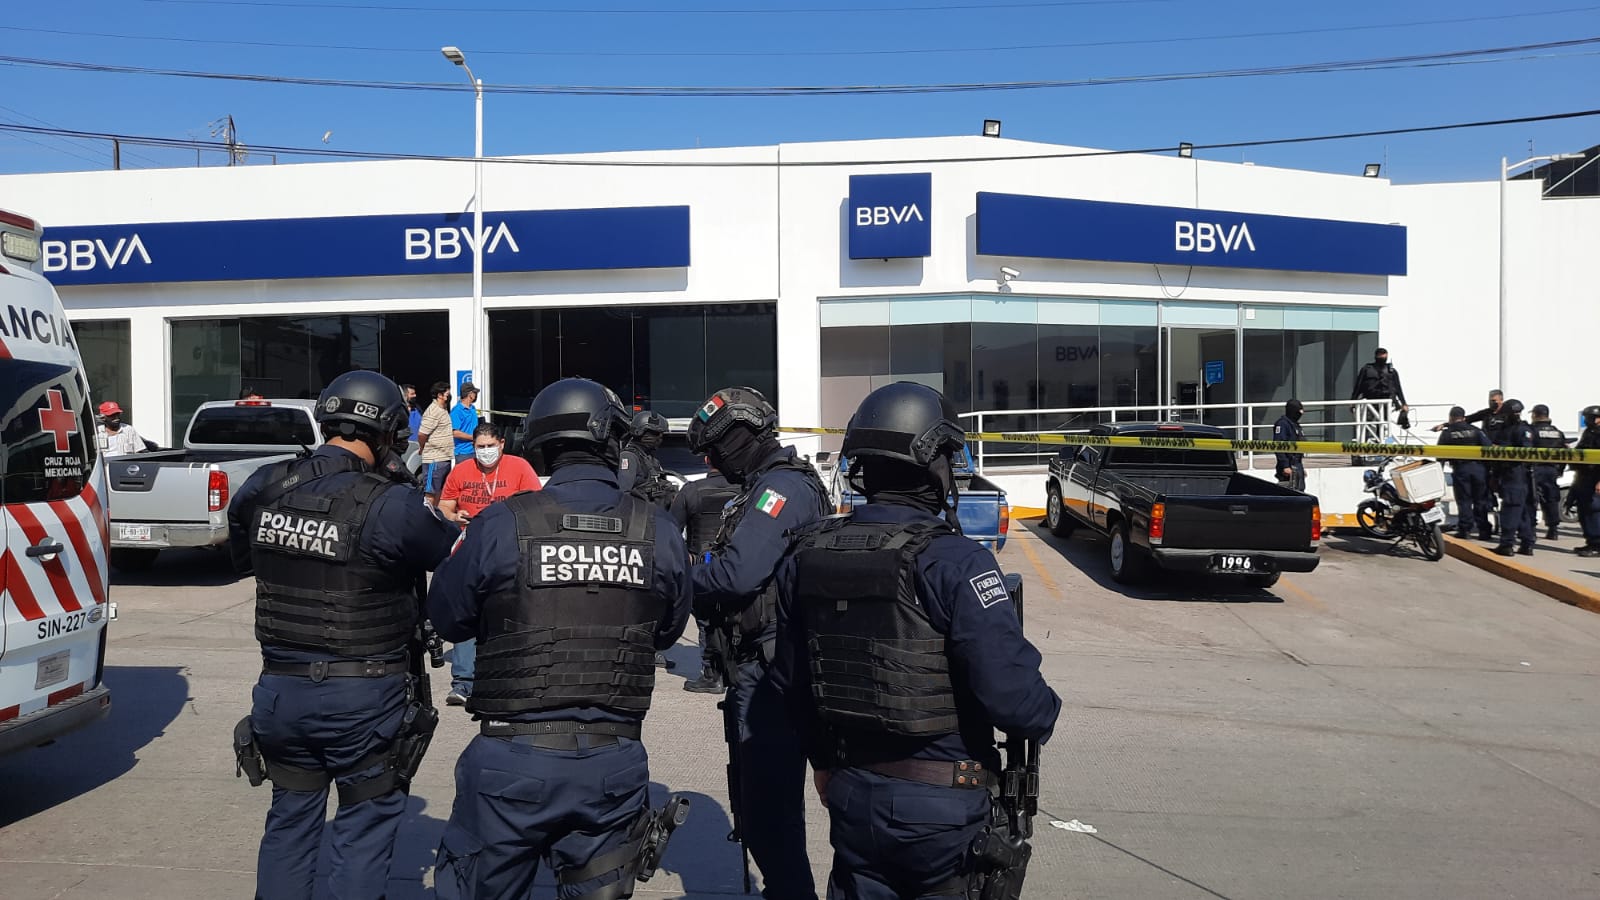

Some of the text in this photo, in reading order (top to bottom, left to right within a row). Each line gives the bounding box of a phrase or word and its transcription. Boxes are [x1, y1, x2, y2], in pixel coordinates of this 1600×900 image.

[857, 203, 924, 226] BBVA
[405, 221, 520, 260] BBVA
[1175, 221, 1256, 254] BBVA
[42, 233, 152, 272] BBVA
[44, 457, 81, 466] CRUZ ROJA
[44, 468, 82, 477] MEXICANA
[260, 511, 339, 542] POLICÍA
[257, 527, 336, 557] ESTATAL
[540, 545, 645, 567] POLICÍA
[1222, 557, 1250, 569] 1996
[540, 564, 645, 585] ESTATAL
[976, 576, 999, 591] FUERZA
[981, 587, 1005, 602] ESTATAL
[37, 613, 86, 640] SIN-227
